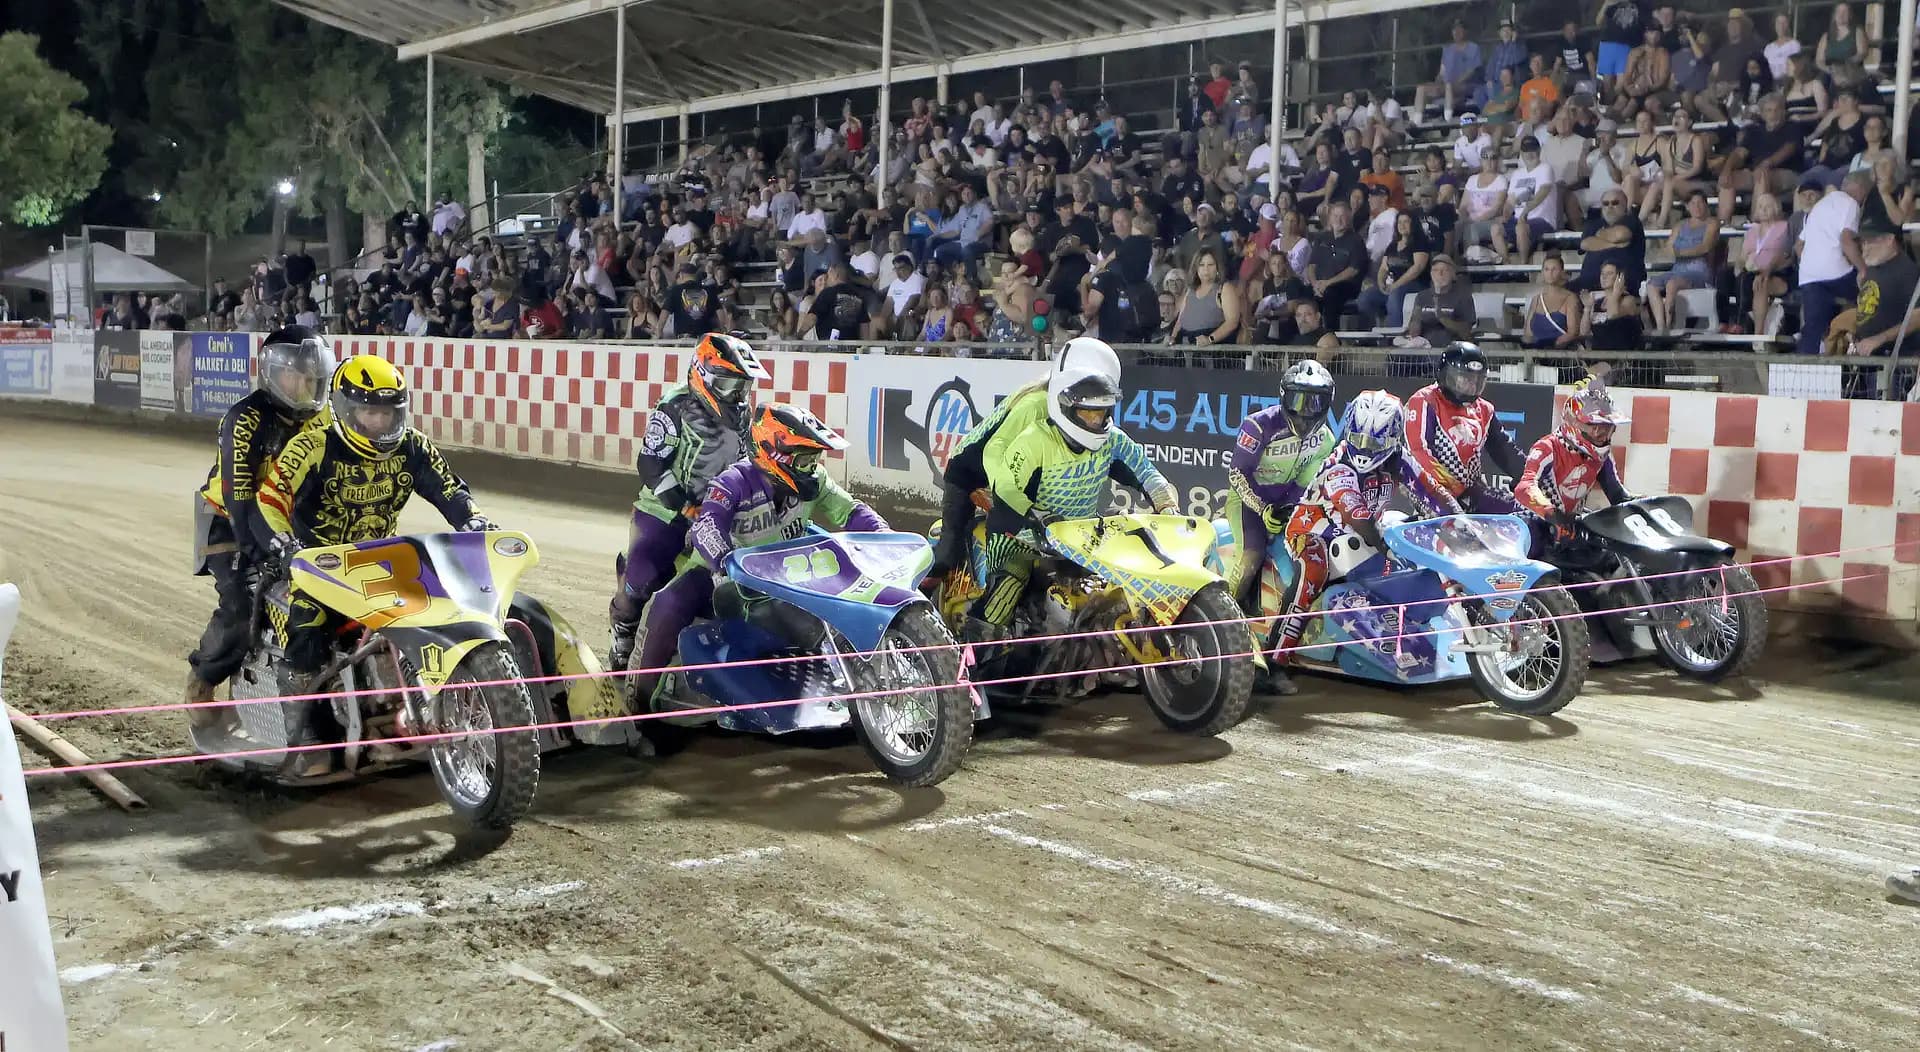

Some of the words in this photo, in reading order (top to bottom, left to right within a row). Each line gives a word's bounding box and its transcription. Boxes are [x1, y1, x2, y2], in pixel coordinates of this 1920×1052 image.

[208, 335, 234, 353] Carol's
[195, 356, 224, 372] MARKET
[231, 358, 247, 373] DELI
[1137, 443, 1218, 467] ENDENT
[1265, 440, 1300, 456] TEAM
[346, 488, 365, 501] FREE
[731, 507, 781, 534] TEAM
[1623, 508, 1685, 550] 88
[1124, 526, 1177, 570] 1
[343, 542, 432, 631] 3
